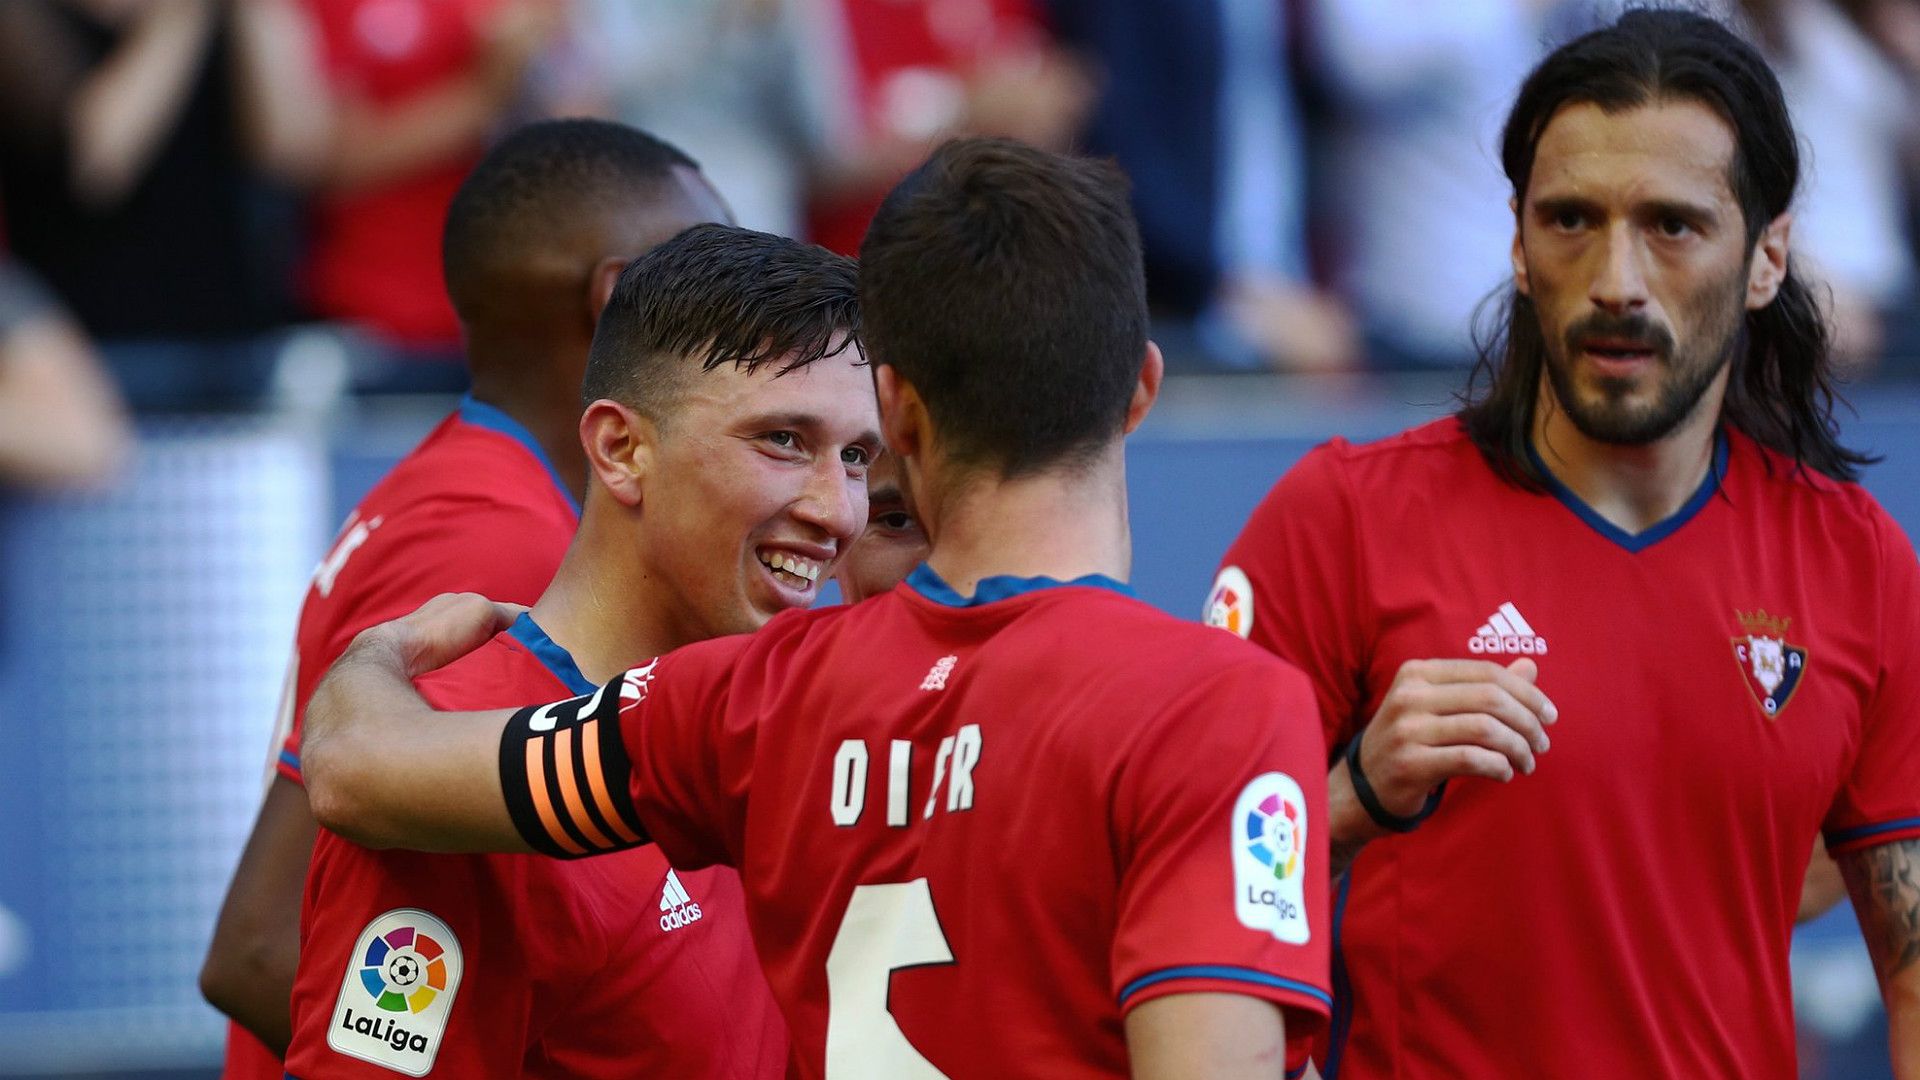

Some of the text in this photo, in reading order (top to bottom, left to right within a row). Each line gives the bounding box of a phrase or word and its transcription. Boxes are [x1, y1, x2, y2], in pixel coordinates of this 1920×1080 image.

[1468, 634, 1548, 655] adidas
[660, 903, 703, 931] adidas
[342, 1008, 428, 1053] LaLiga
